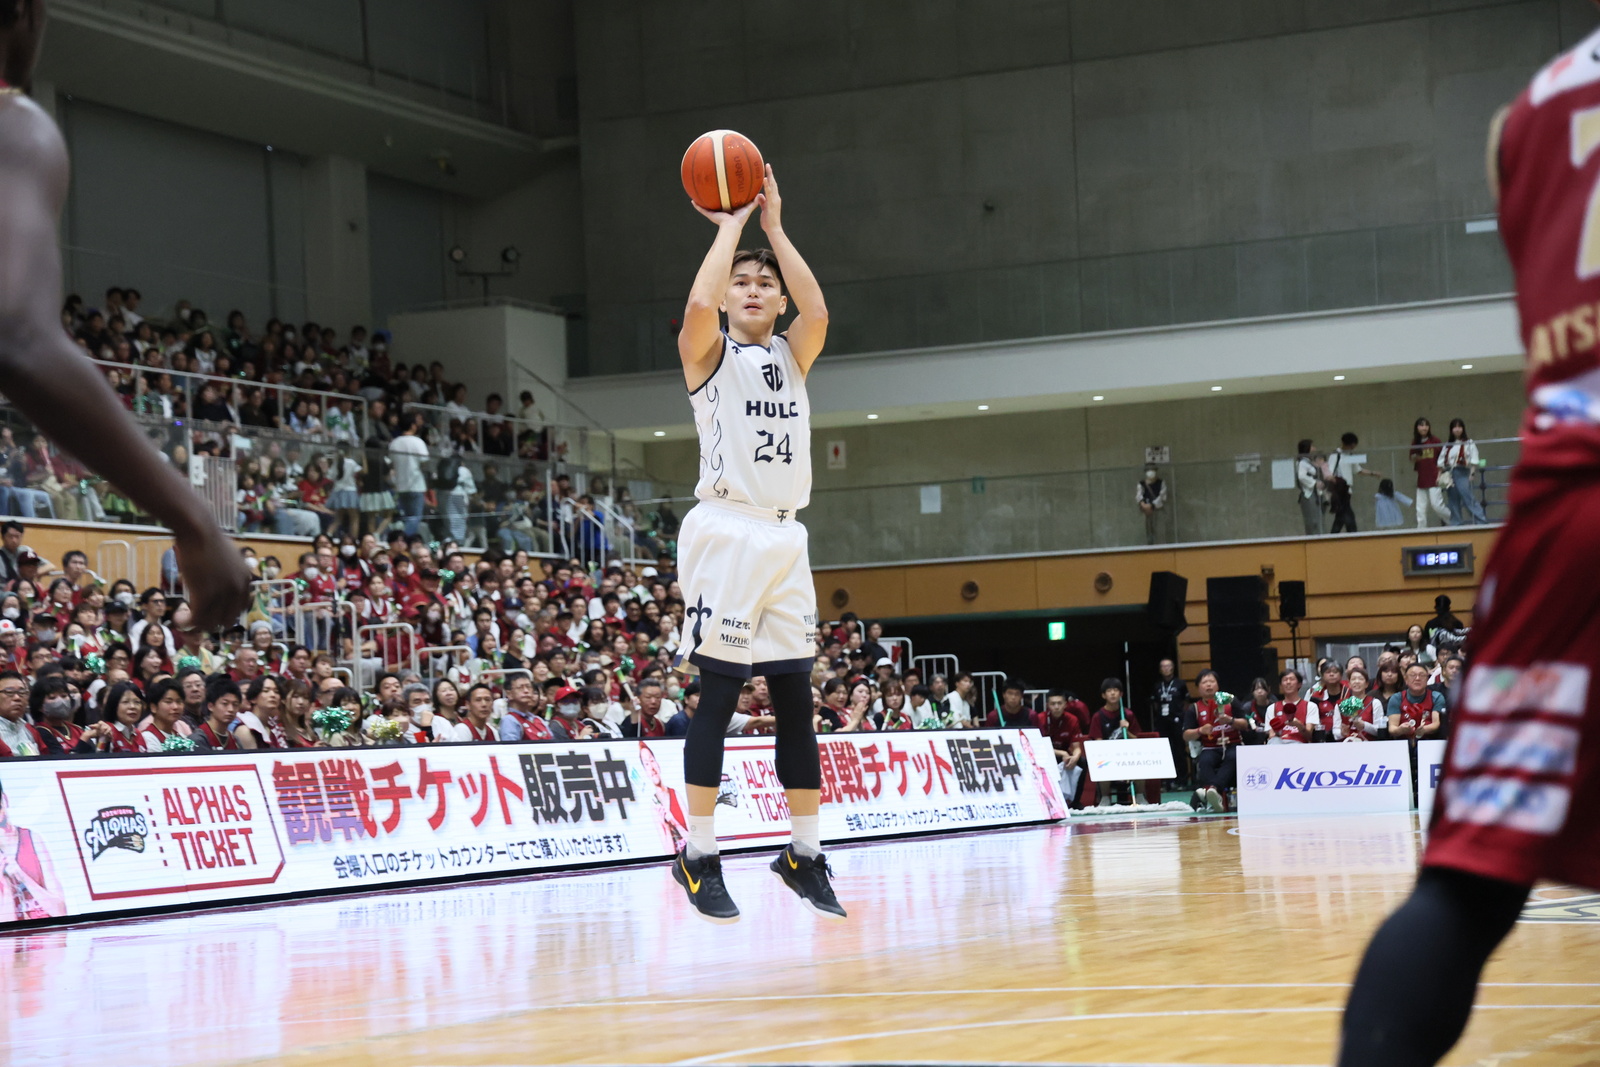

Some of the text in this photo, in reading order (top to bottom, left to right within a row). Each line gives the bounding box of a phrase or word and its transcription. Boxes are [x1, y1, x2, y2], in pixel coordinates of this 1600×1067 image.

[754, 429, 793, 465] 24
[720, 633, 750, 645] MIZUHO
[1115, 759, 1162, 767] YAMAICHI
[1275, 764, 1403, 792] Kyoshin
[163, 785, 252, 825] ALPHAS
[272, 749, 636, 846] 観戦チケット販売中
[85, 814, 147, 857] ALPHAS
[172, 828, 257, 870] TICKET
